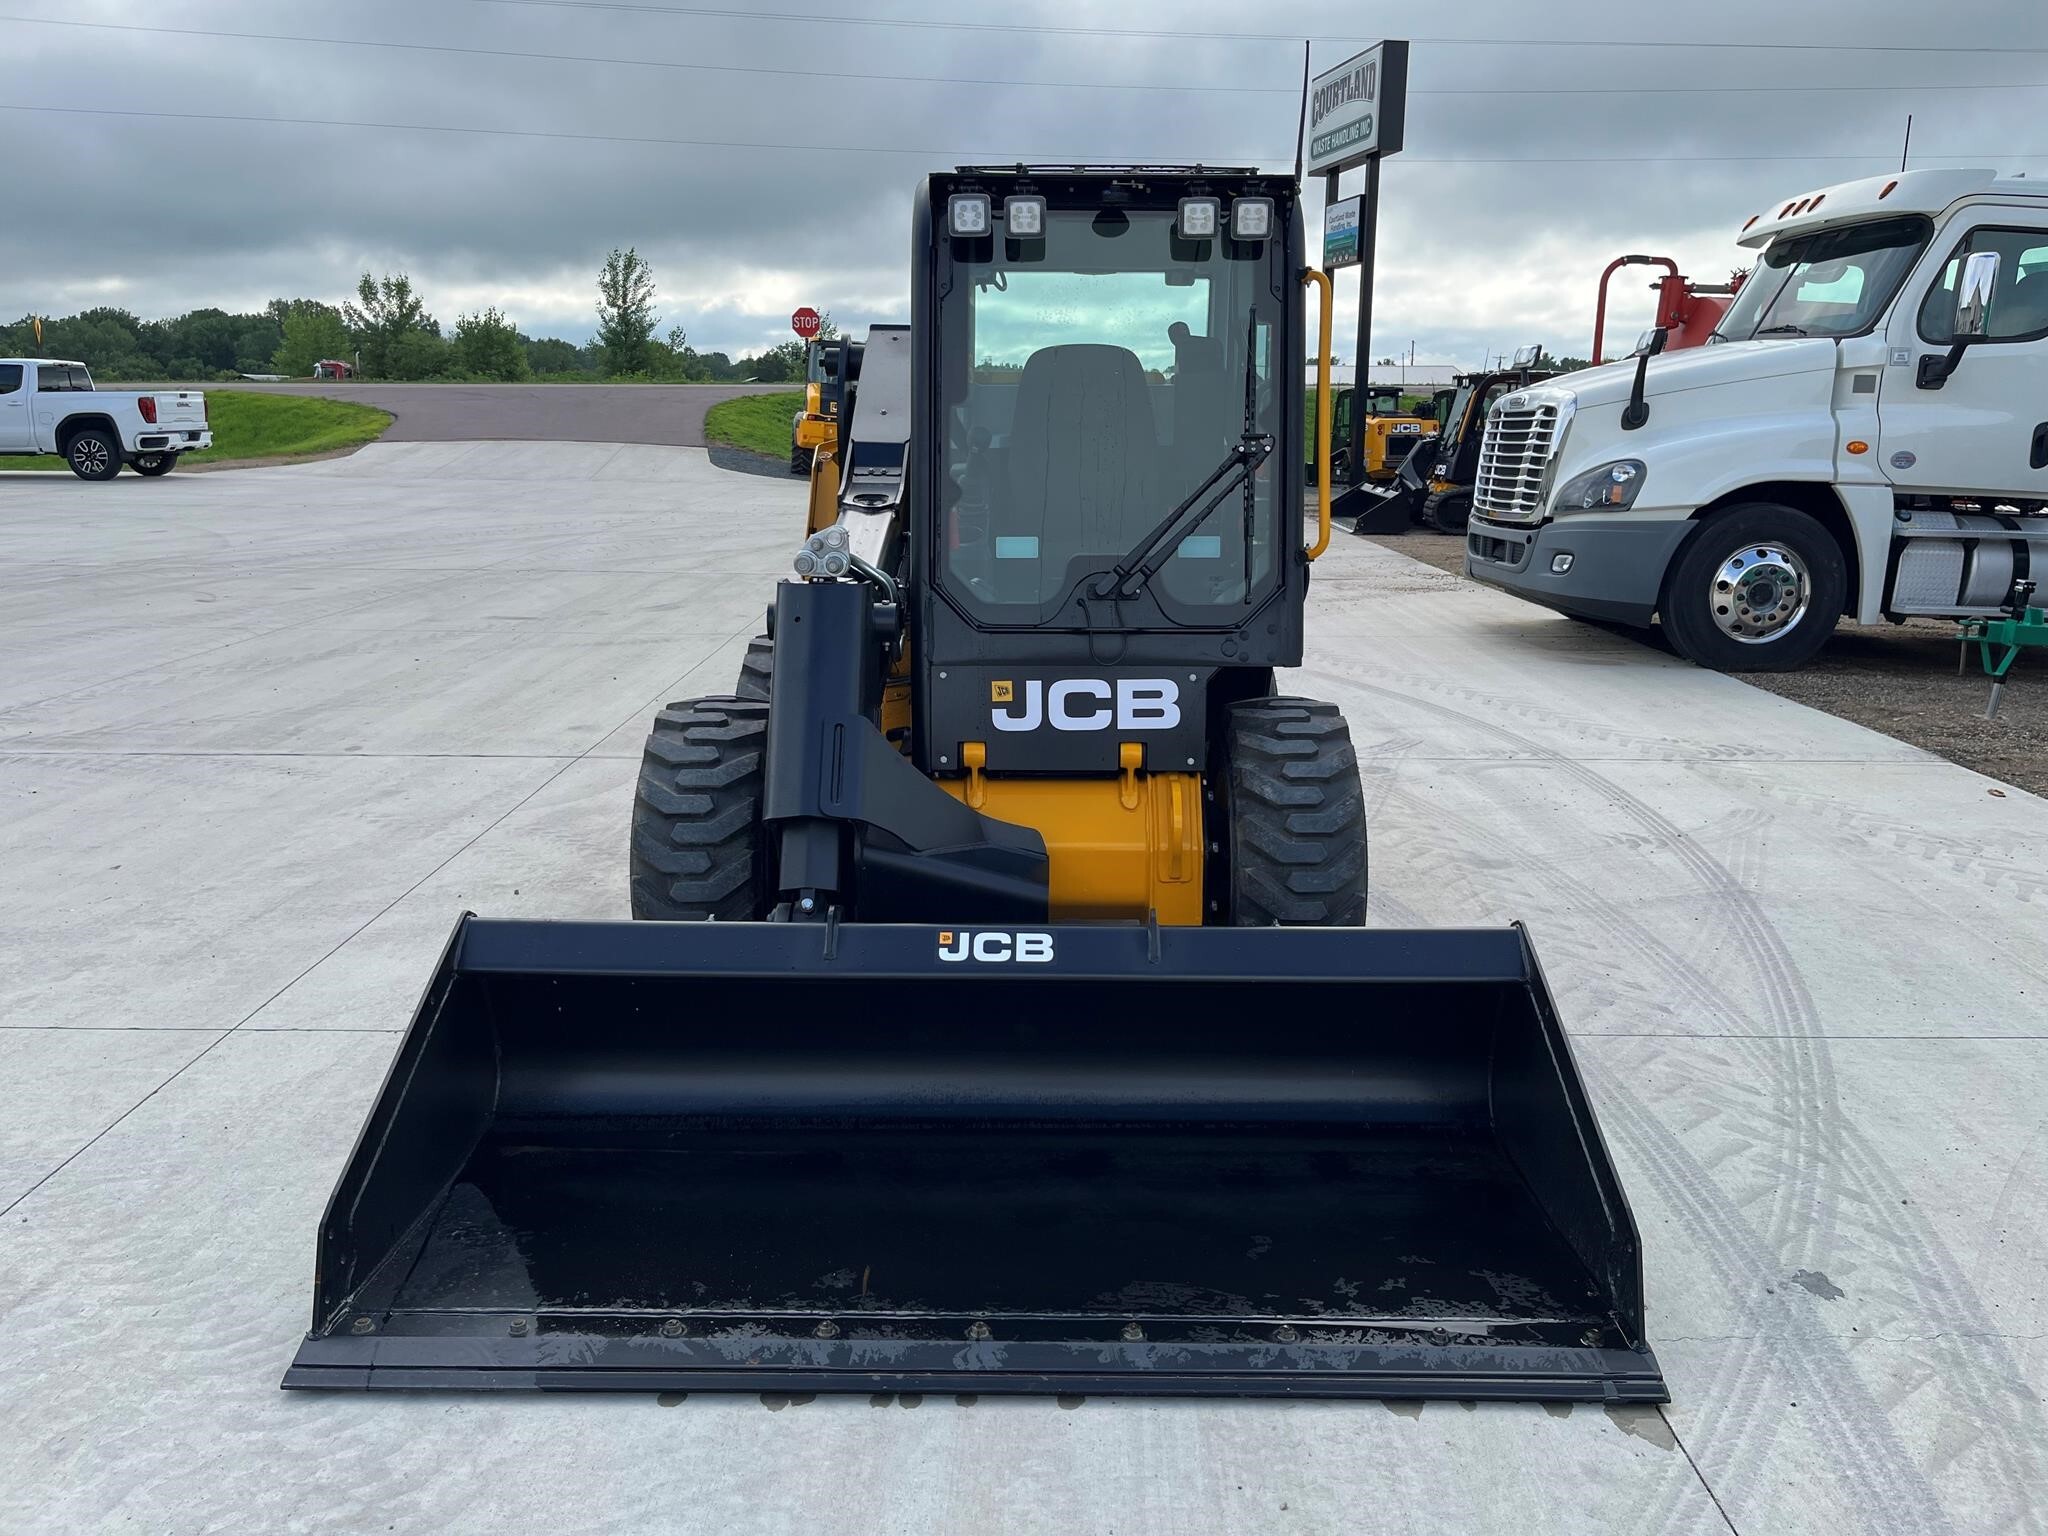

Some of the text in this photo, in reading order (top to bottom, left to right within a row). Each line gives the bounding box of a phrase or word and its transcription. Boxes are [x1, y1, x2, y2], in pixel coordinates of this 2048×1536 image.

[1312, 61, 1377, 129] COURTLAND
[1312, 117, 1371, 156] WASTE HANDLING INC
[793, 316, 819, 328] STOP
[1392, 423, 1421, 433] JCB
[1434, 464, 1446, 475] JCB
[991, 678, 1181, 732] JCB
[938, 932, 1054, 962] JCB
